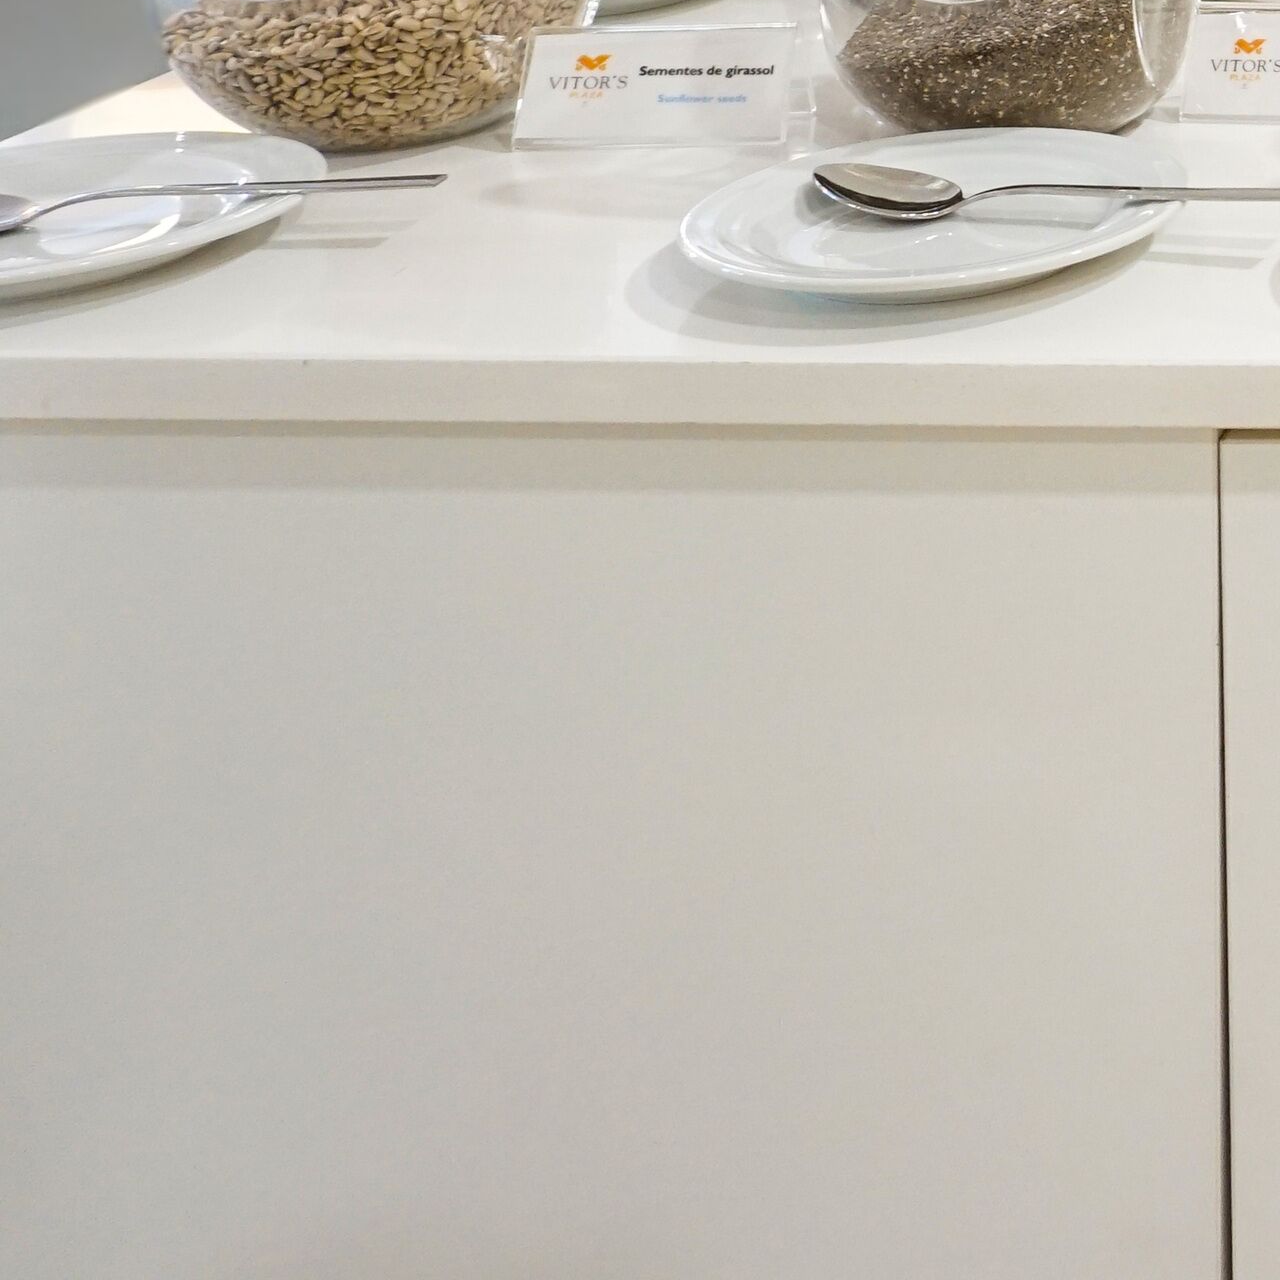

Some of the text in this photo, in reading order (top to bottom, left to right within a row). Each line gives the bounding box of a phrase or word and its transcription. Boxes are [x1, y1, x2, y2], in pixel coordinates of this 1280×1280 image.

[638, 64, 775, 79] Sementes de girassol
[549, 74, 629, 91] VITOR'S
